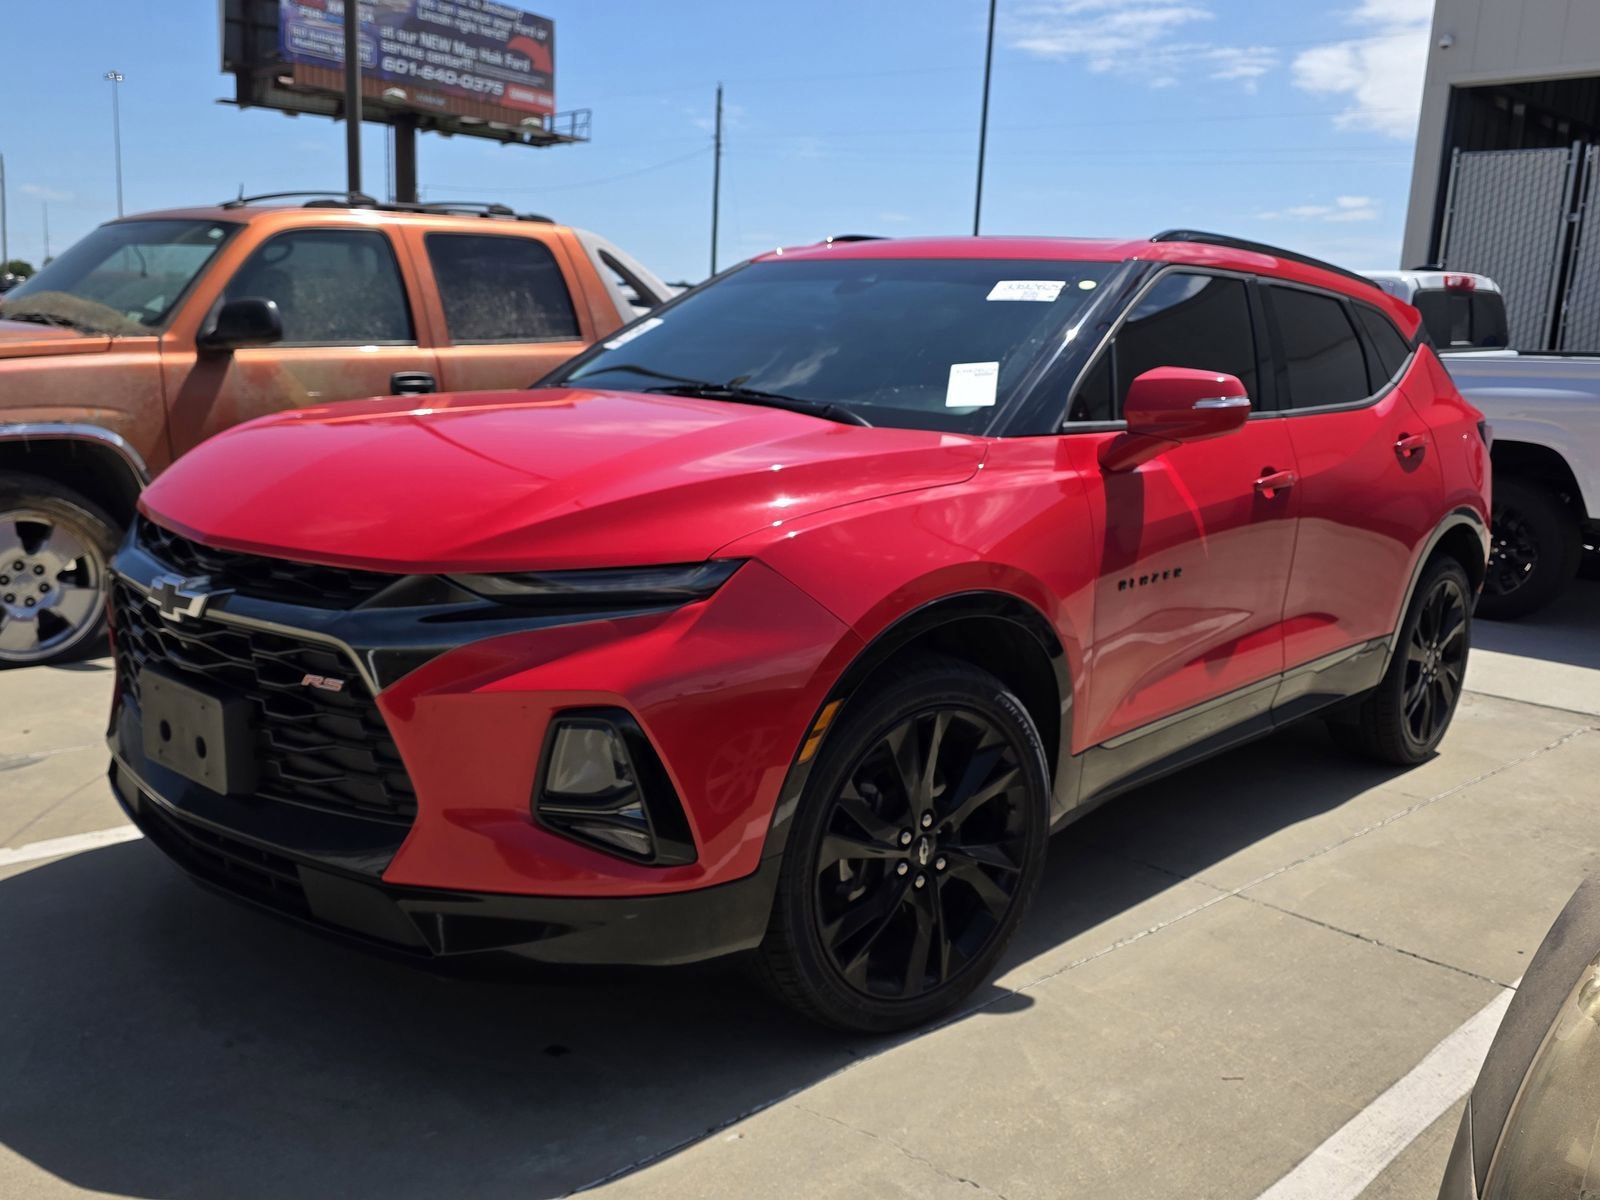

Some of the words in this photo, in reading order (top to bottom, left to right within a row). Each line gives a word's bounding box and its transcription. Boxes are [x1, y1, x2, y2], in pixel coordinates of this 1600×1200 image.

[380, 26, 394, 39] at
[396, 29, 417, 44] our
[419, 31, 452, 52] NEW
[504, 53, 530, 73] Ford
[380, 39, 424, 60] service
[302, 674, 344, 691] RS
